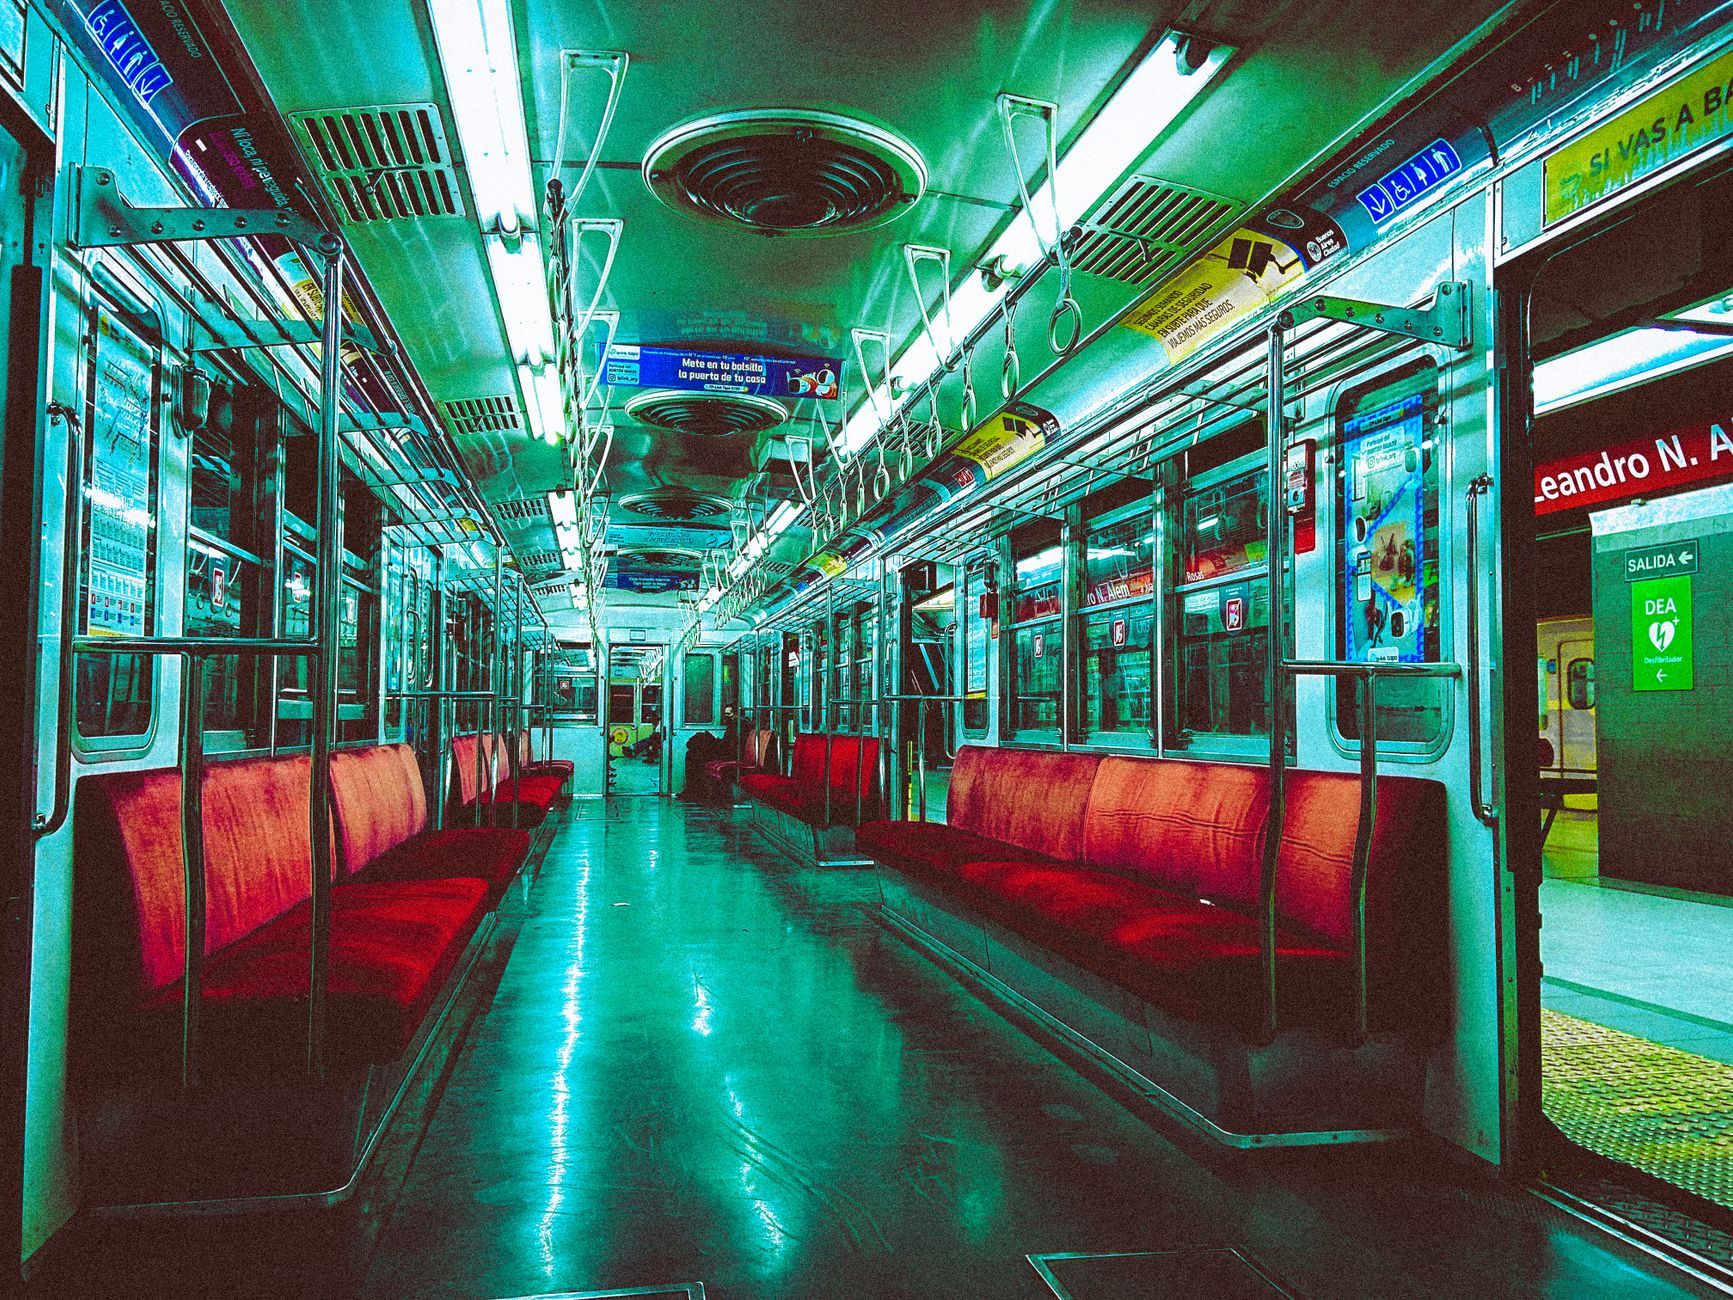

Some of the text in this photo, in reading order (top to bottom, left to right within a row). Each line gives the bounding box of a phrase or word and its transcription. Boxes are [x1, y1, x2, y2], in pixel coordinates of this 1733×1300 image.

[1589, 147, 1609, 178] SI
[1618, 118, 1666, 159] VAS
[1675, 103, 1695, 132] A
[1327, 139, 1395, 189] ESPACIO RESERVADO
[1315, 229, 1334, 243] Buenos
[1320, 238, 1334, 250] Aires
[1323, 241, 1341, 257] Ciudad
[1157, 297, 1213, 338] EN SUBTE PARA QUE
[1168, 299, 1235, 349] VIAJEMOS MÁS SEGUROS.
[682, 358, 763, 372] Mete en tu bolsillo
[678, 369, 766, 384] la puerta de tu casa
[1535, 416, 1733, 503] eandro N. A
[1628, 553, 1675, 572] SALIDA
[1186, 571, 1204, 581] Rosas
[1107, 582, 1131, 600] Alem
[1645, 597, 1677, 615] DEA
